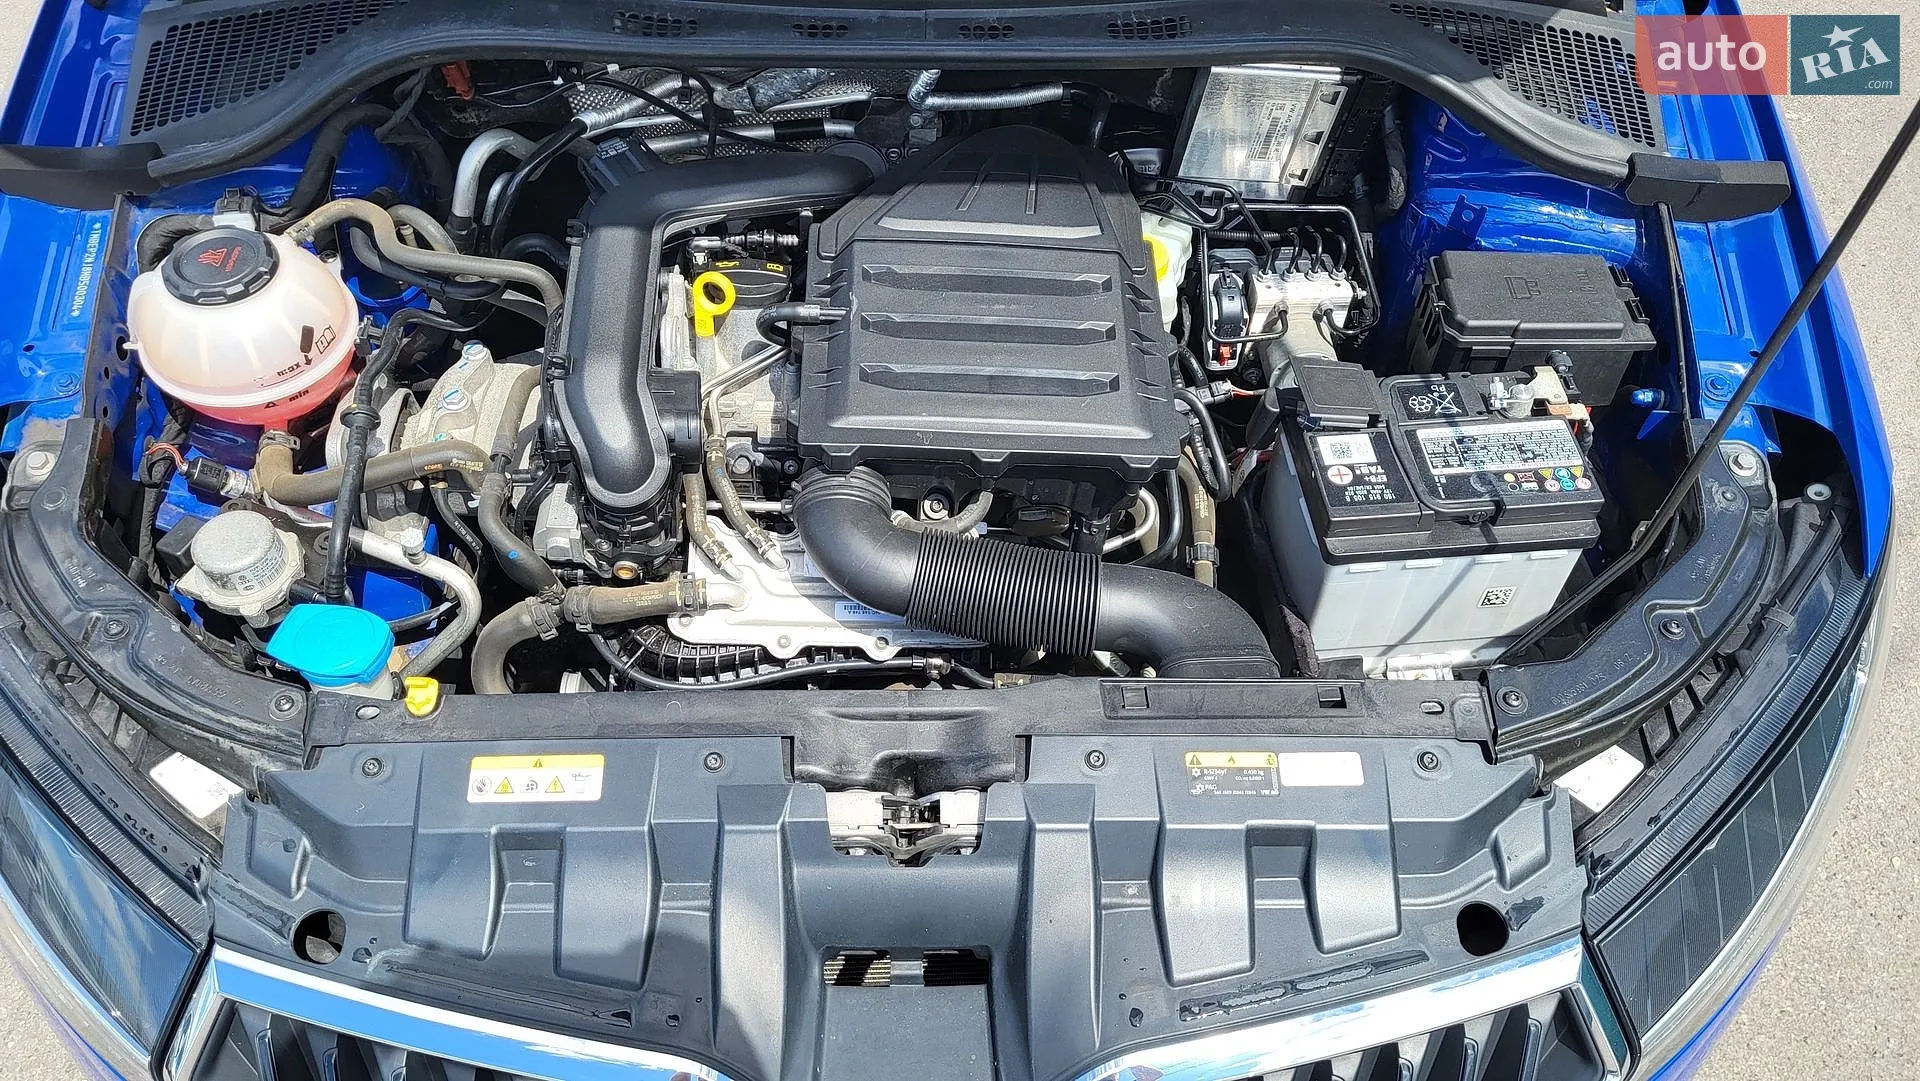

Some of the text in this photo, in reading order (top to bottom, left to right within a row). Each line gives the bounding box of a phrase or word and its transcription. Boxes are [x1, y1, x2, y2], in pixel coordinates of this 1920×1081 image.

[1430, 384, 1446, 392] Pb
[289, 389, 310, 402] min
[1364, 474, 1388, 483] EFB+
